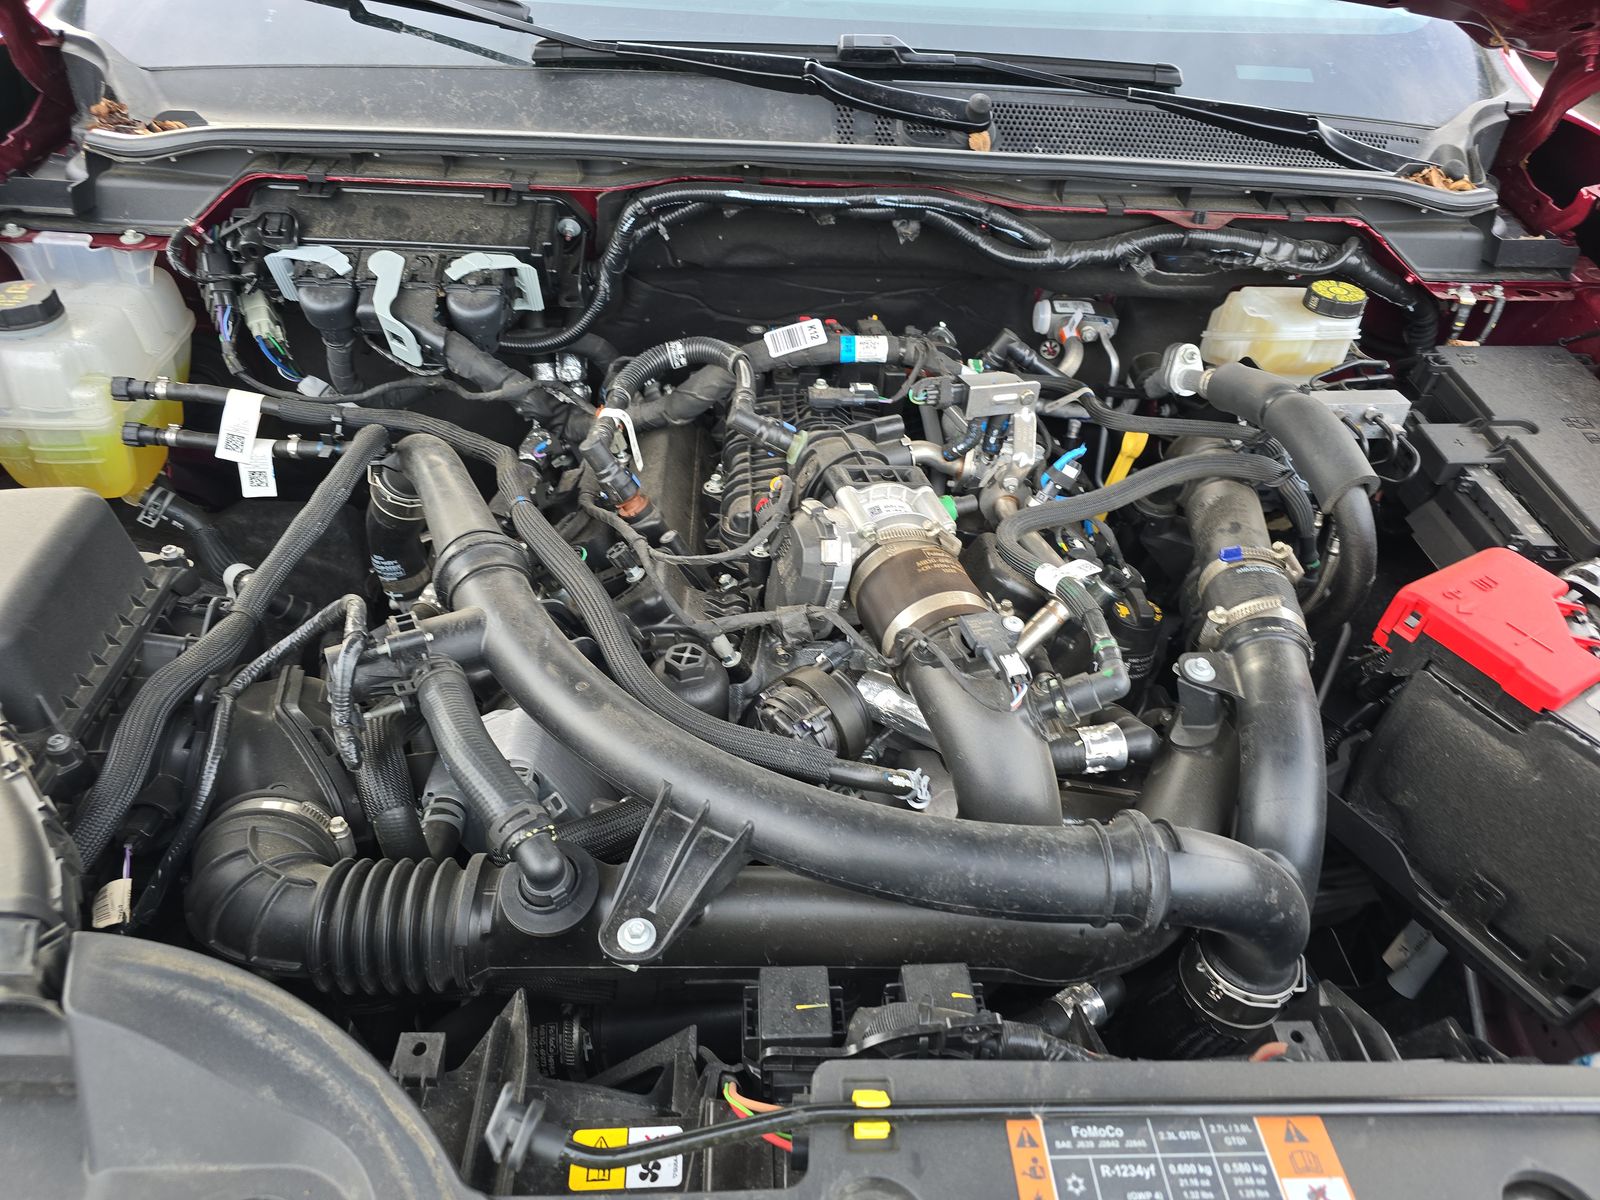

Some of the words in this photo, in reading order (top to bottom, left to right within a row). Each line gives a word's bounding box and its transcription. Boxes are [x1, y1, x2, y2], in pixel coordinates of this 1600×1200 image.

[806, 324, 820, 341] K12
[1071, 1124, 1124, 1138] FoMoCo
[1100, 1163, 1156, 1180] R-1234yf
[1197, 1162, 1213, 1177] kg
[1252, 1161, 1267, 1176] kg
